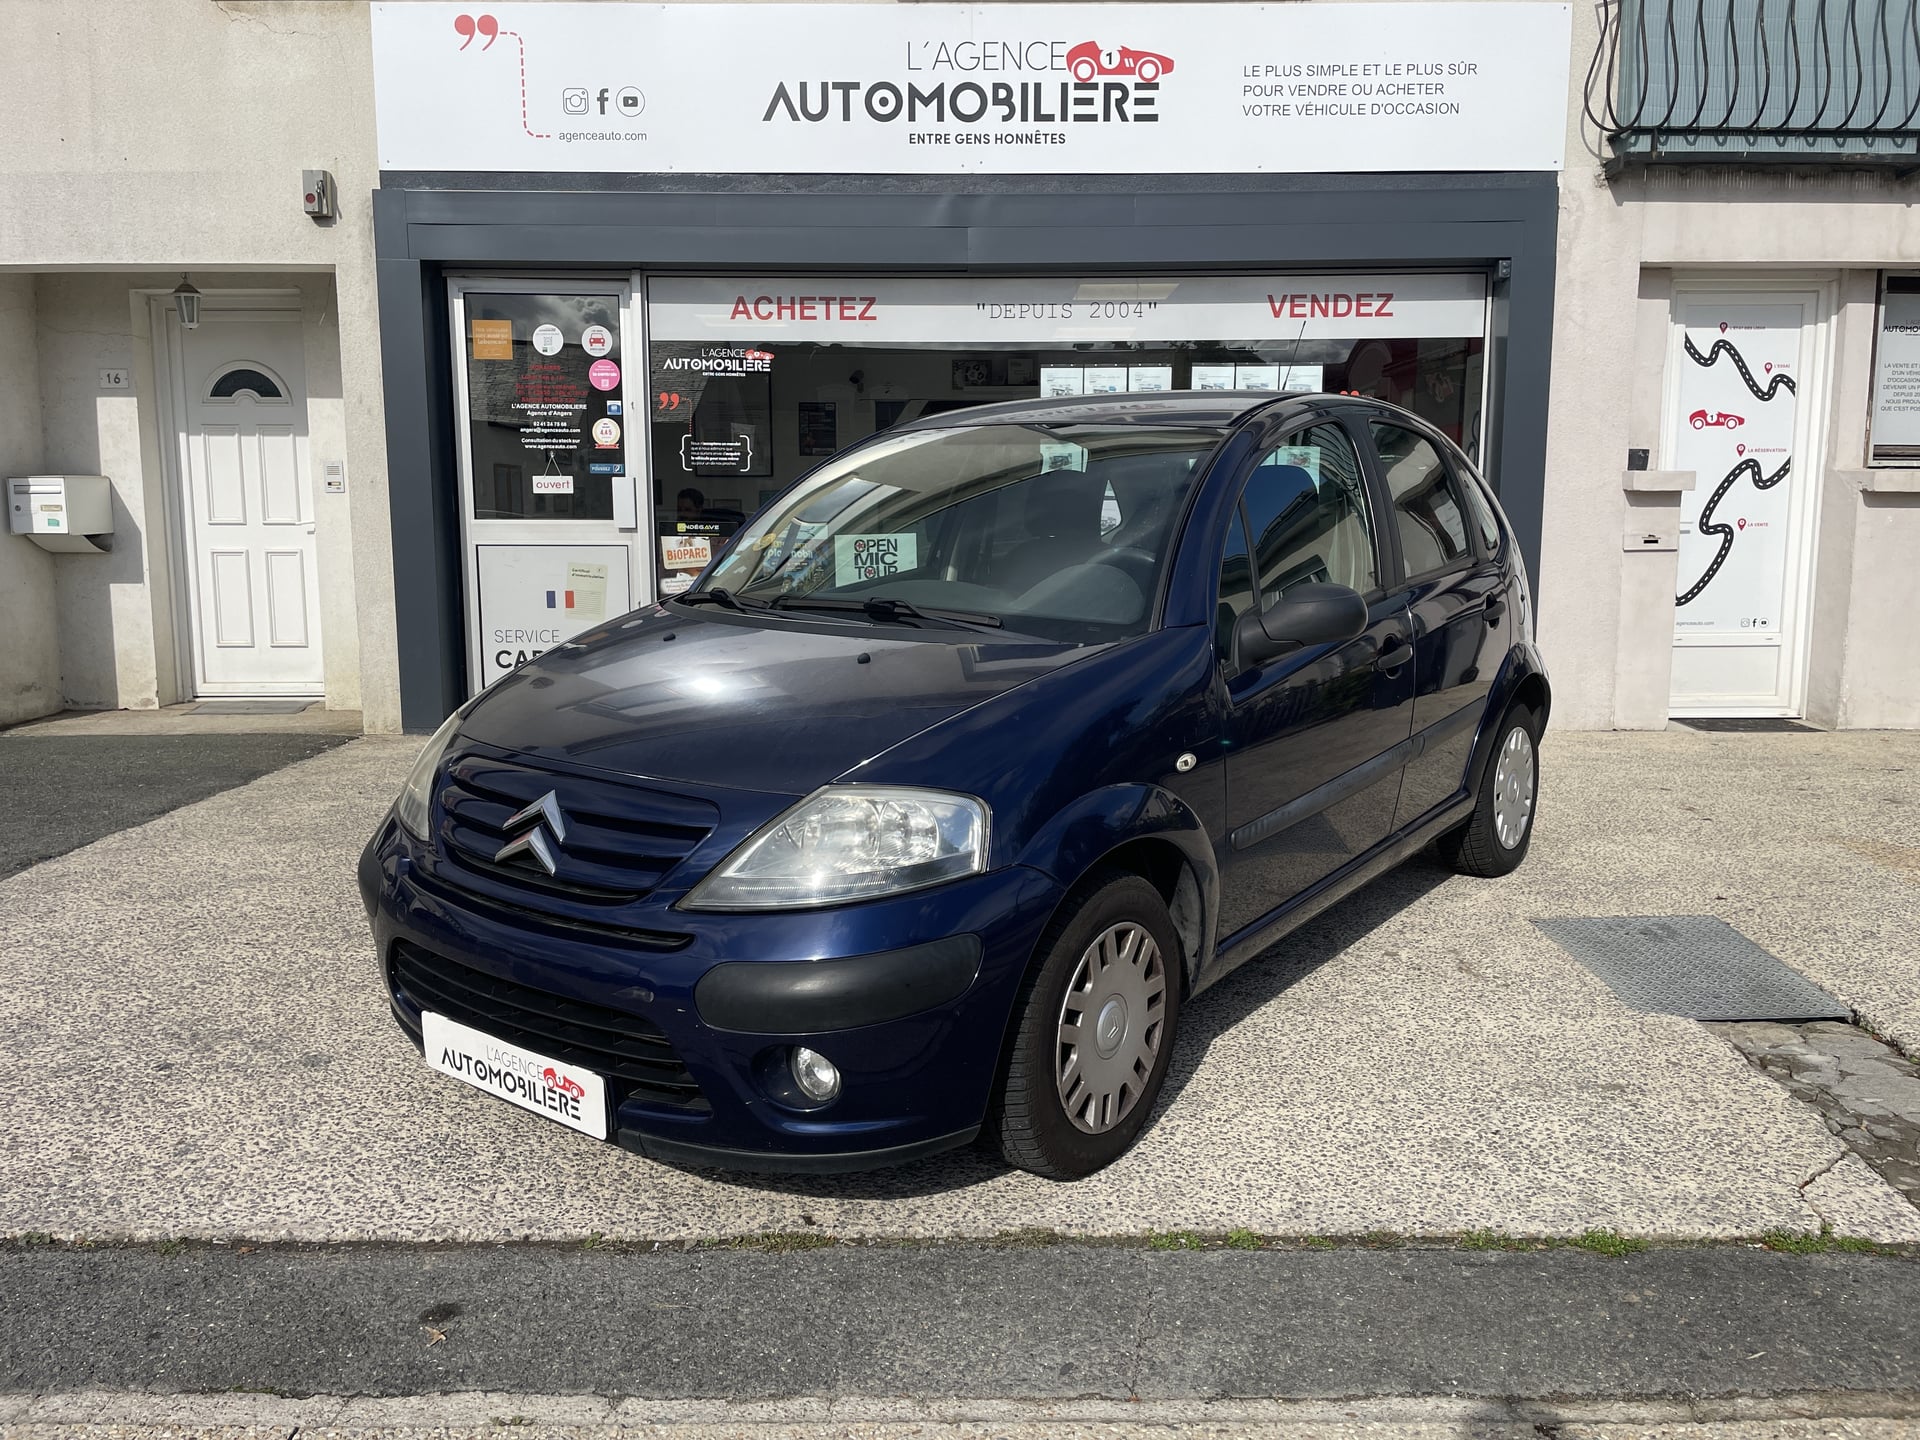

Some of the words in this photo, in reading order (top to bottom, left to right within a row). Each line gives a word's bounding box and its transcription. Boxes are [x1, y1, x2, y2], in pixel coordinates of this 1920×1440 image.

[907, 41, 1067, 71] L'AGENCE
[1243, 65, 1261, 77] LE
[1265, 65, 1302, 77] PLUS
[1306, 64, 1359, 77] SIMPLE
[1363, 64, 1381, 76] ET
[1385, 64, 1403, 76] LE
[1406, 63, 1444, 76] PLUS
[1448, 61, 1478, 75] SÛR
[1243, 85, 1284, 97] POUR
[1288, 84, 1347, 97] VENDRE
[1352, 84, 1373, 96] OU
[1376, 83, 1444, 96] ACHETER
[1242, 104, 1291, 116] VOTRE
[1295, 101, 1366, 116] VÉHICULE
[1370, 103, 1460, 115] D'OCCASION
[559, 131, 647, 143] agenceauto.com
[908, 133, 951, 145] ENTRE
[954, 133, 991, 145] GENS
[995, 130, 1066, 145] HONNÊTES
[730, 296, 877, 321] ACHETEZ
[976, 303, 1073, 319] "DEPUIS
[1090, 302, 1157, 319] 2004"
[1267, 293, 1394, 318] VENDEZ
[701, 348, 745, 358] L'AGENCE
[106, 373, 121, 384] 16
[535, 480, 570, 489] ouvert
[854, 538, 898, 553] OPEN
[854, 552, 898, 566] MIC
[494, 629, 560, 643] SERVICE
[486, 1045, 543, 1081] L'AGENCE
